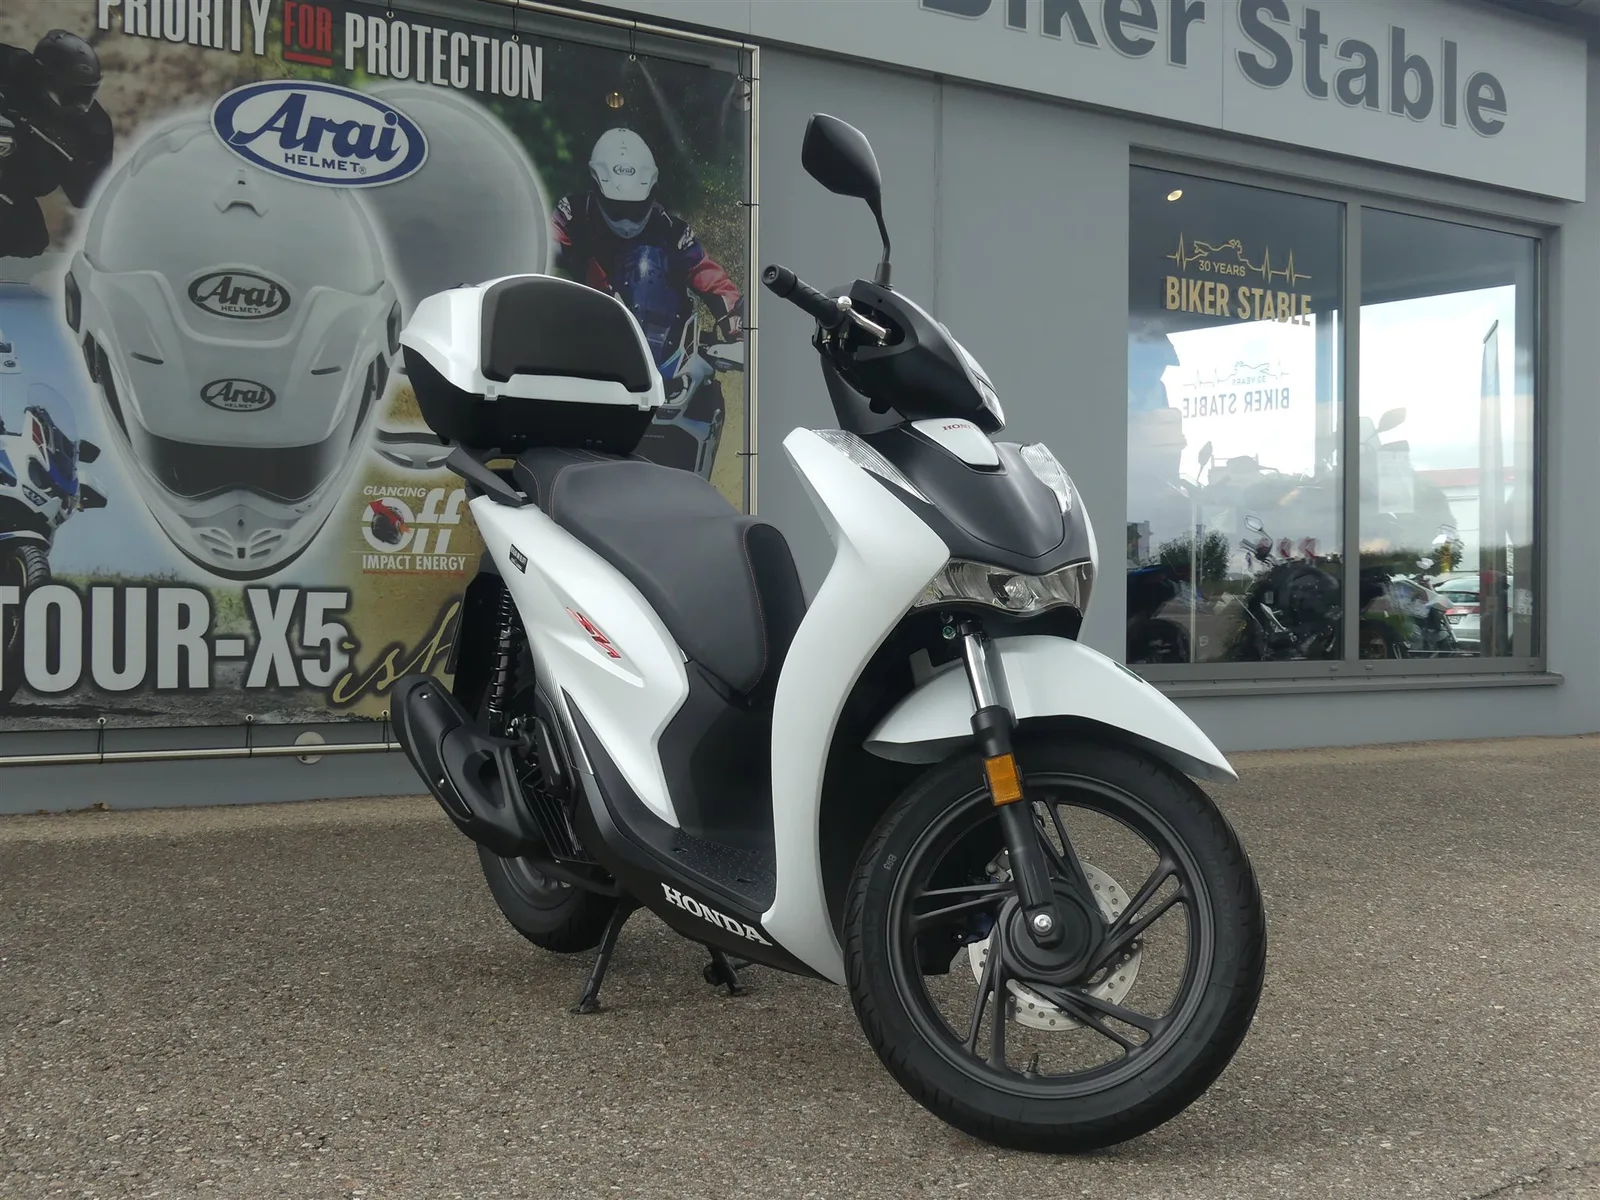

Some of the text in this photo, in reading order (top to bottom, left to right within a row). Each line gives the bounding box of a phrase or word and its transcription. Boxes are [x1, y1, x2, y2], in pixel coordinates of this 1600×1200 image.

[283, 2, 333, 52] FOR
[345, 12, 543, 102] PROTECTION
[919, 0, 1508, 137] ker Stable
[229, 92, 401, 162] Arai
[196, 276, 278, 308] Arai
[1198, 259, 1246, 277] 30 YEARS
[1166, 275, 1312, 327] BIKER STABLE
[206, 381, 268, 404] Arai
[363, 485, 426, 497] GLANCING
[361, 487, 466, 554] Off
[362, 555, 466, 571] IMPACT ENERGY
[661, 882, 773, 946] HONDA
